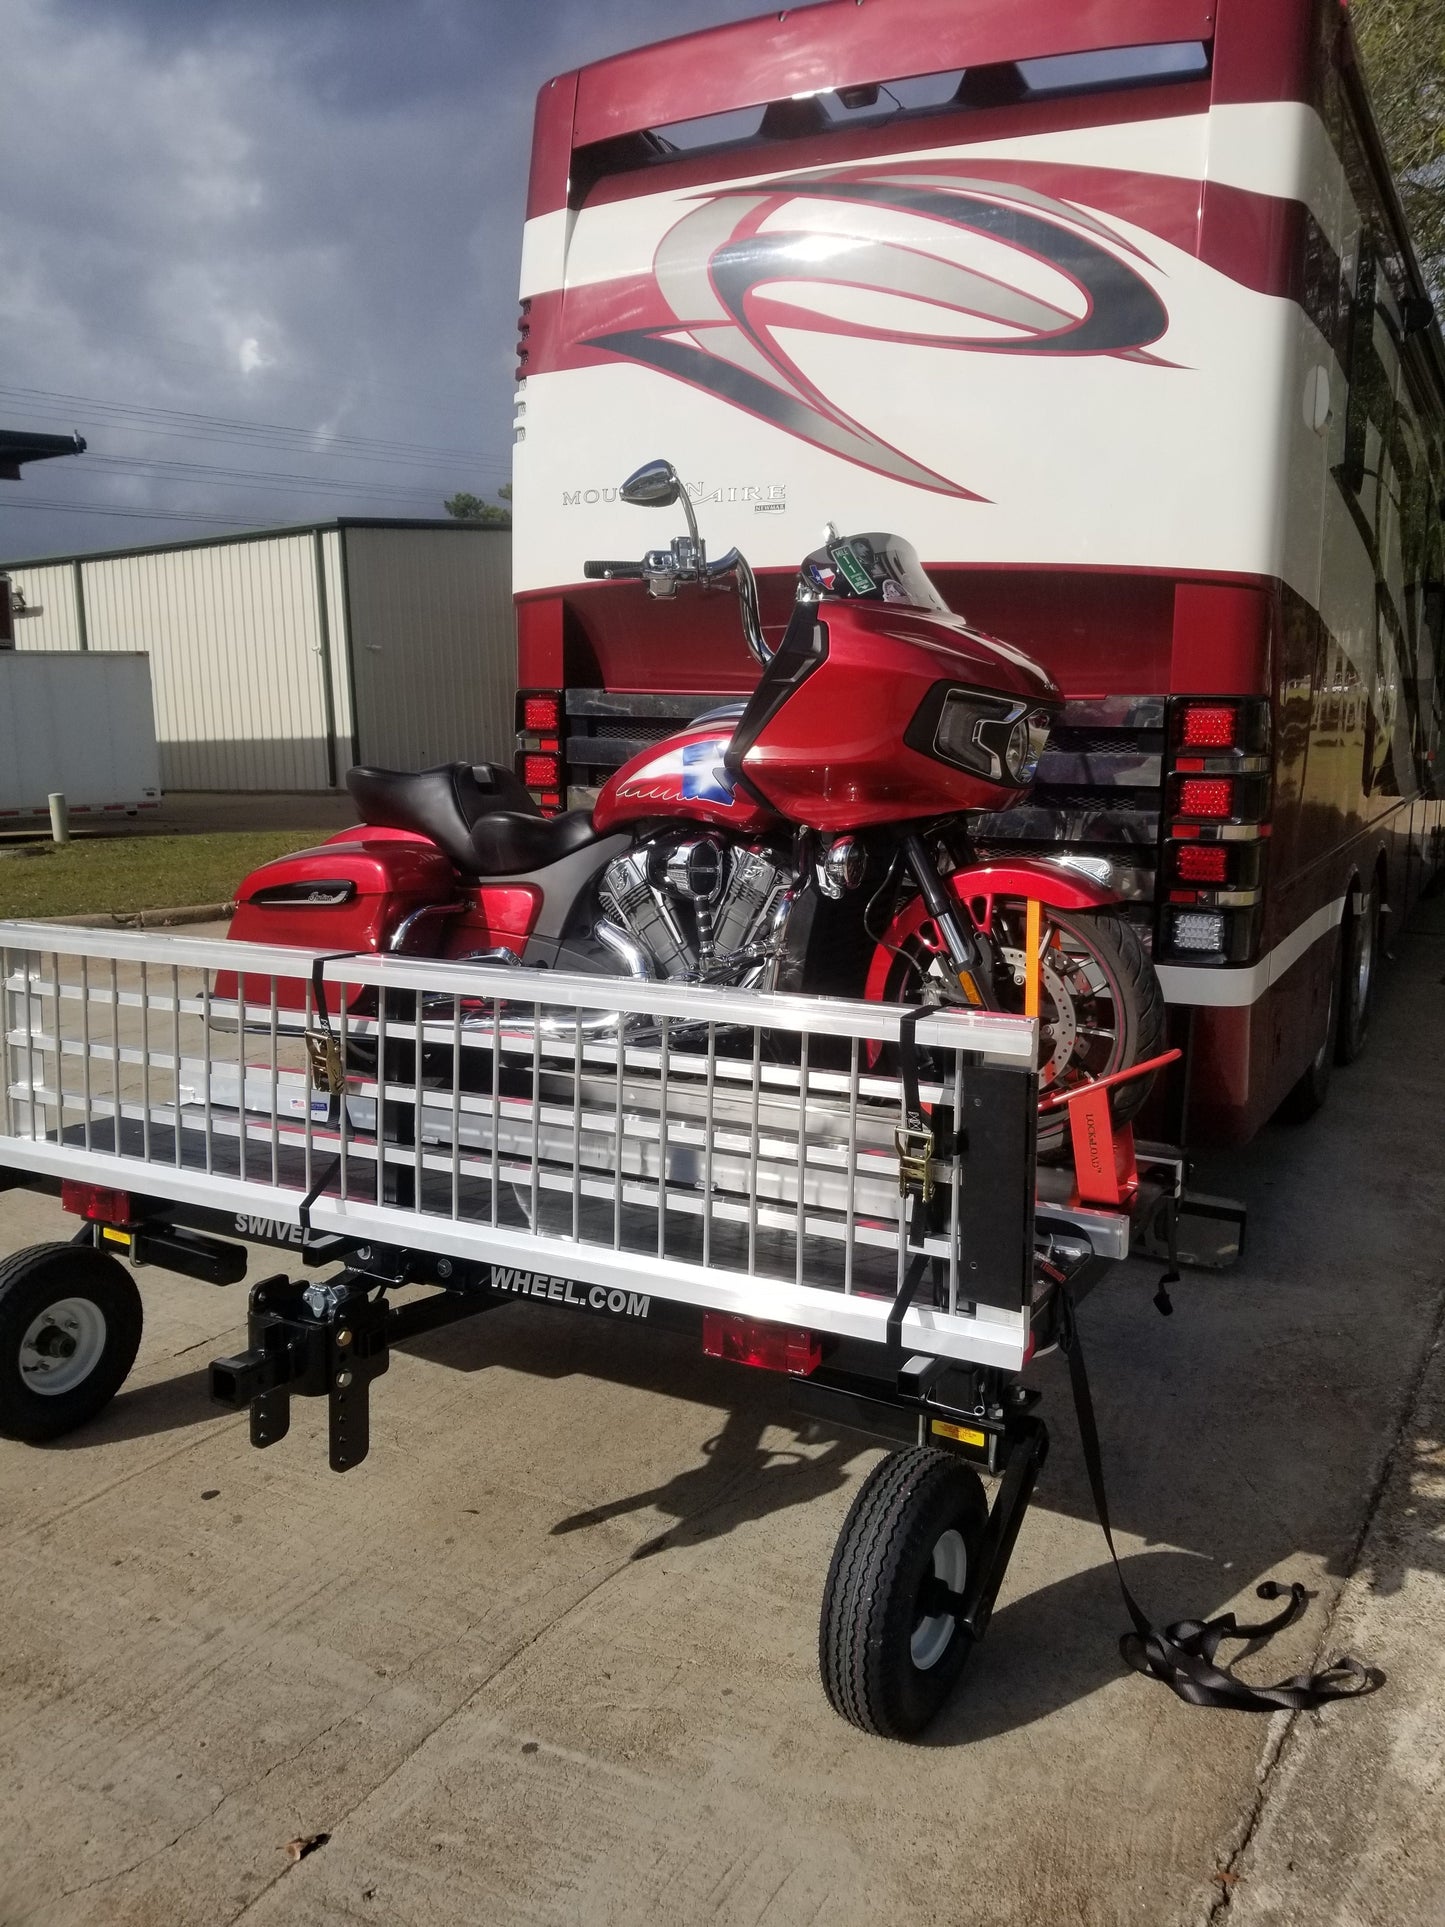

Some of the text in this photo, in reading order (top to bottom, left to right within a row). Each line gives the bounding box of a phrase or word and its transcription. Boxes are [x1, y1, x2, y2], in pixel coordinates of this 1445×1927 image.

[307, 891, 334, 902] Indian
[233, 1212, 651, 1318] SWIVEL WHEEL.COM
